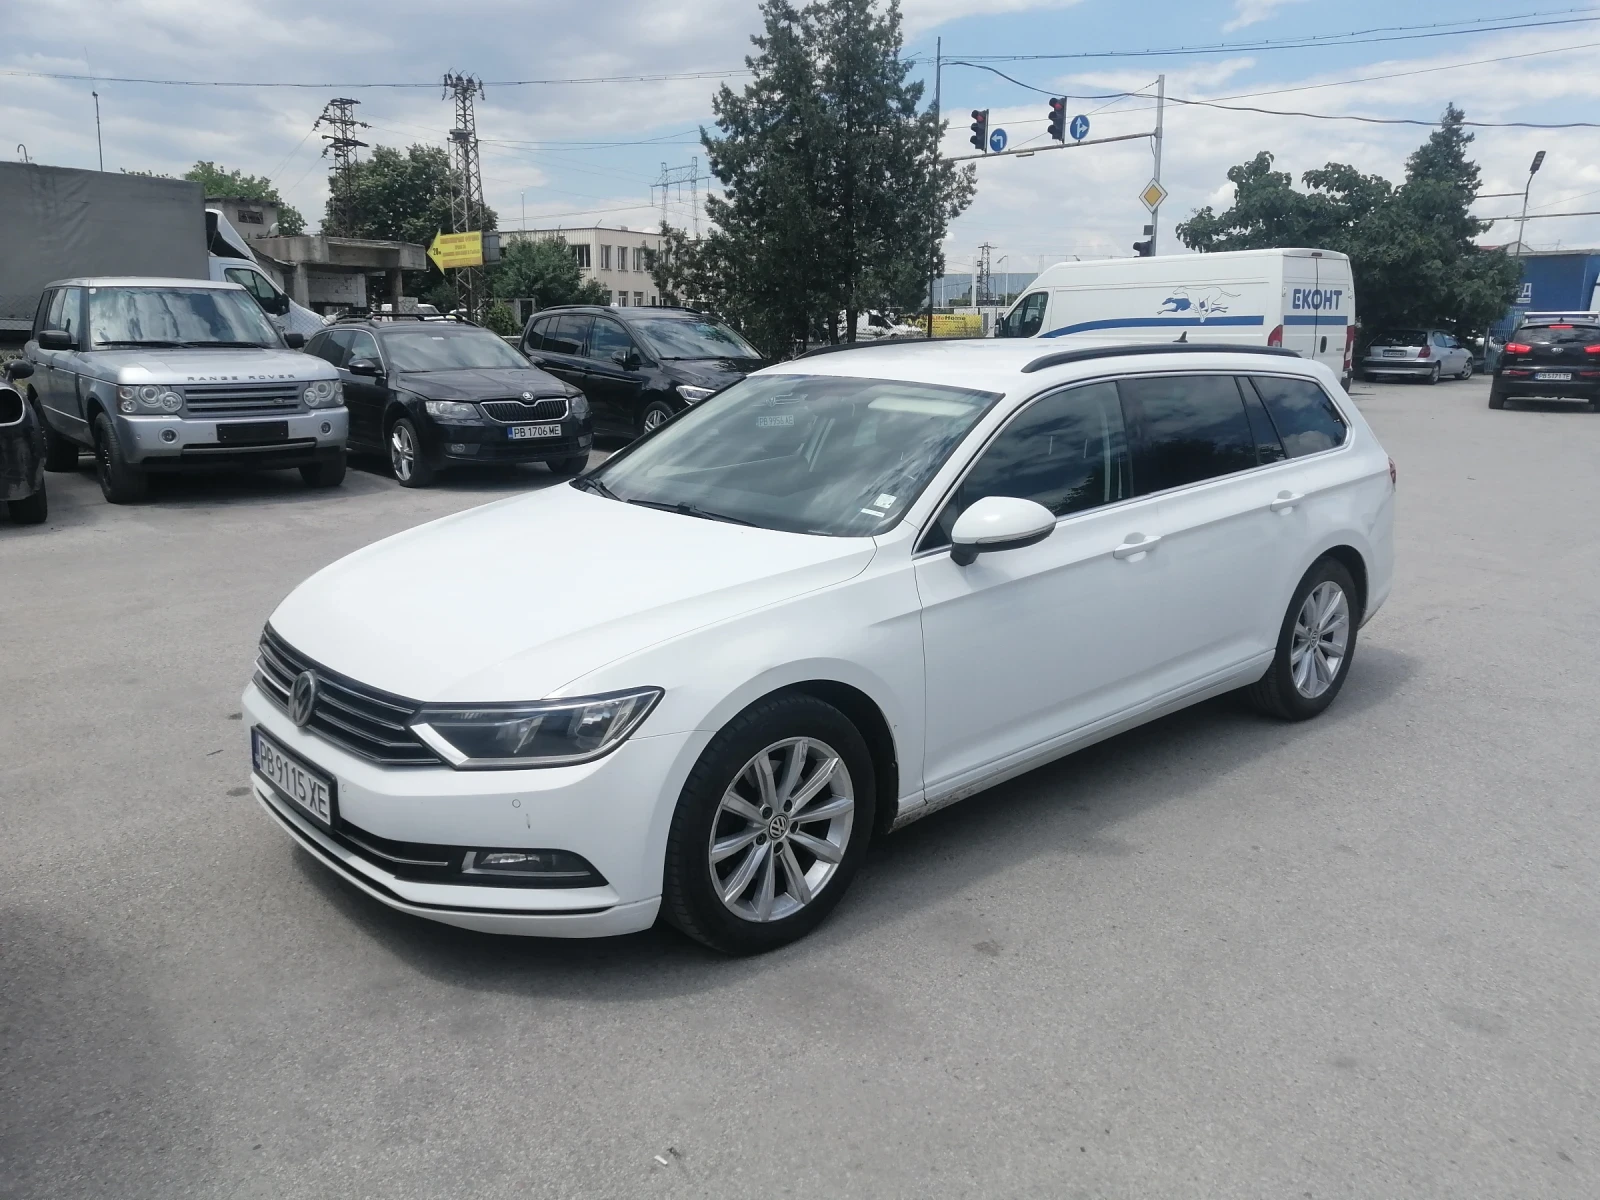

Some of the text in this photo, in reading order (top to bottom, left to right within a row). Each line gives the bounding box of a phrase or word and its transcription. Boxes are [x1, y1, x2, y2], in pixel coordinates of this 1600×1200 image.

[514, 425, 560, 437] PB 1706 ME
[259, 739, 328, 818] PB 9115 XE
